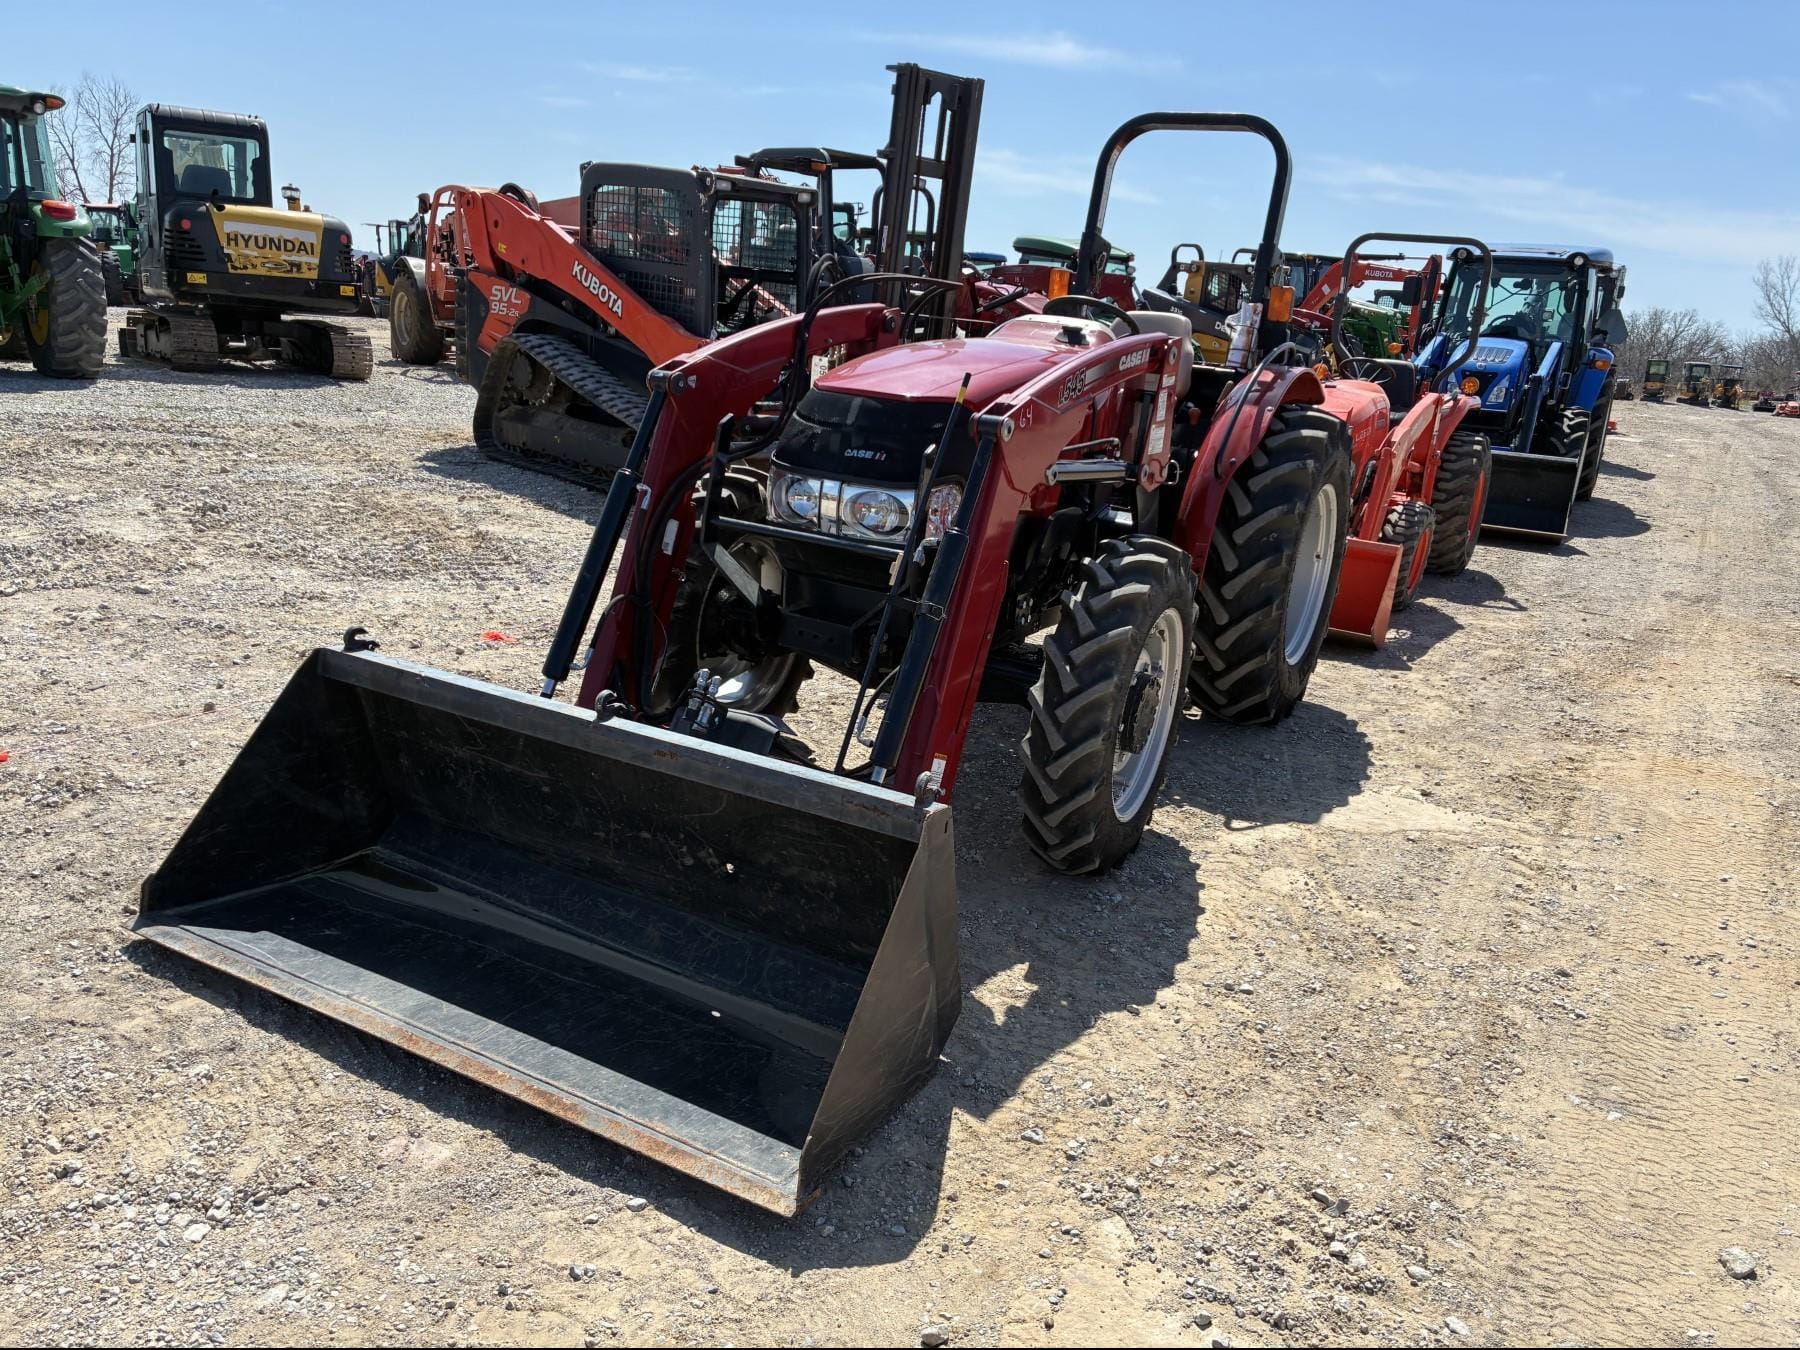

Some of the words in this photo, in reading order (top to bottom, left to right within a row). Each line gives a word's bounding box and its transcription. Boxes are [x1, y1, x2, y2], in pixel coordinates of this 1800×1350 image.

[226, 231, 315, 256] HYUNDAI
[1364, 269, 1393, 279] KUBOTA
[490, 285, 522, 305] SVL
[572, 260, 623, 318] KUBOTA
[844, 449, 874, 459] CASE
